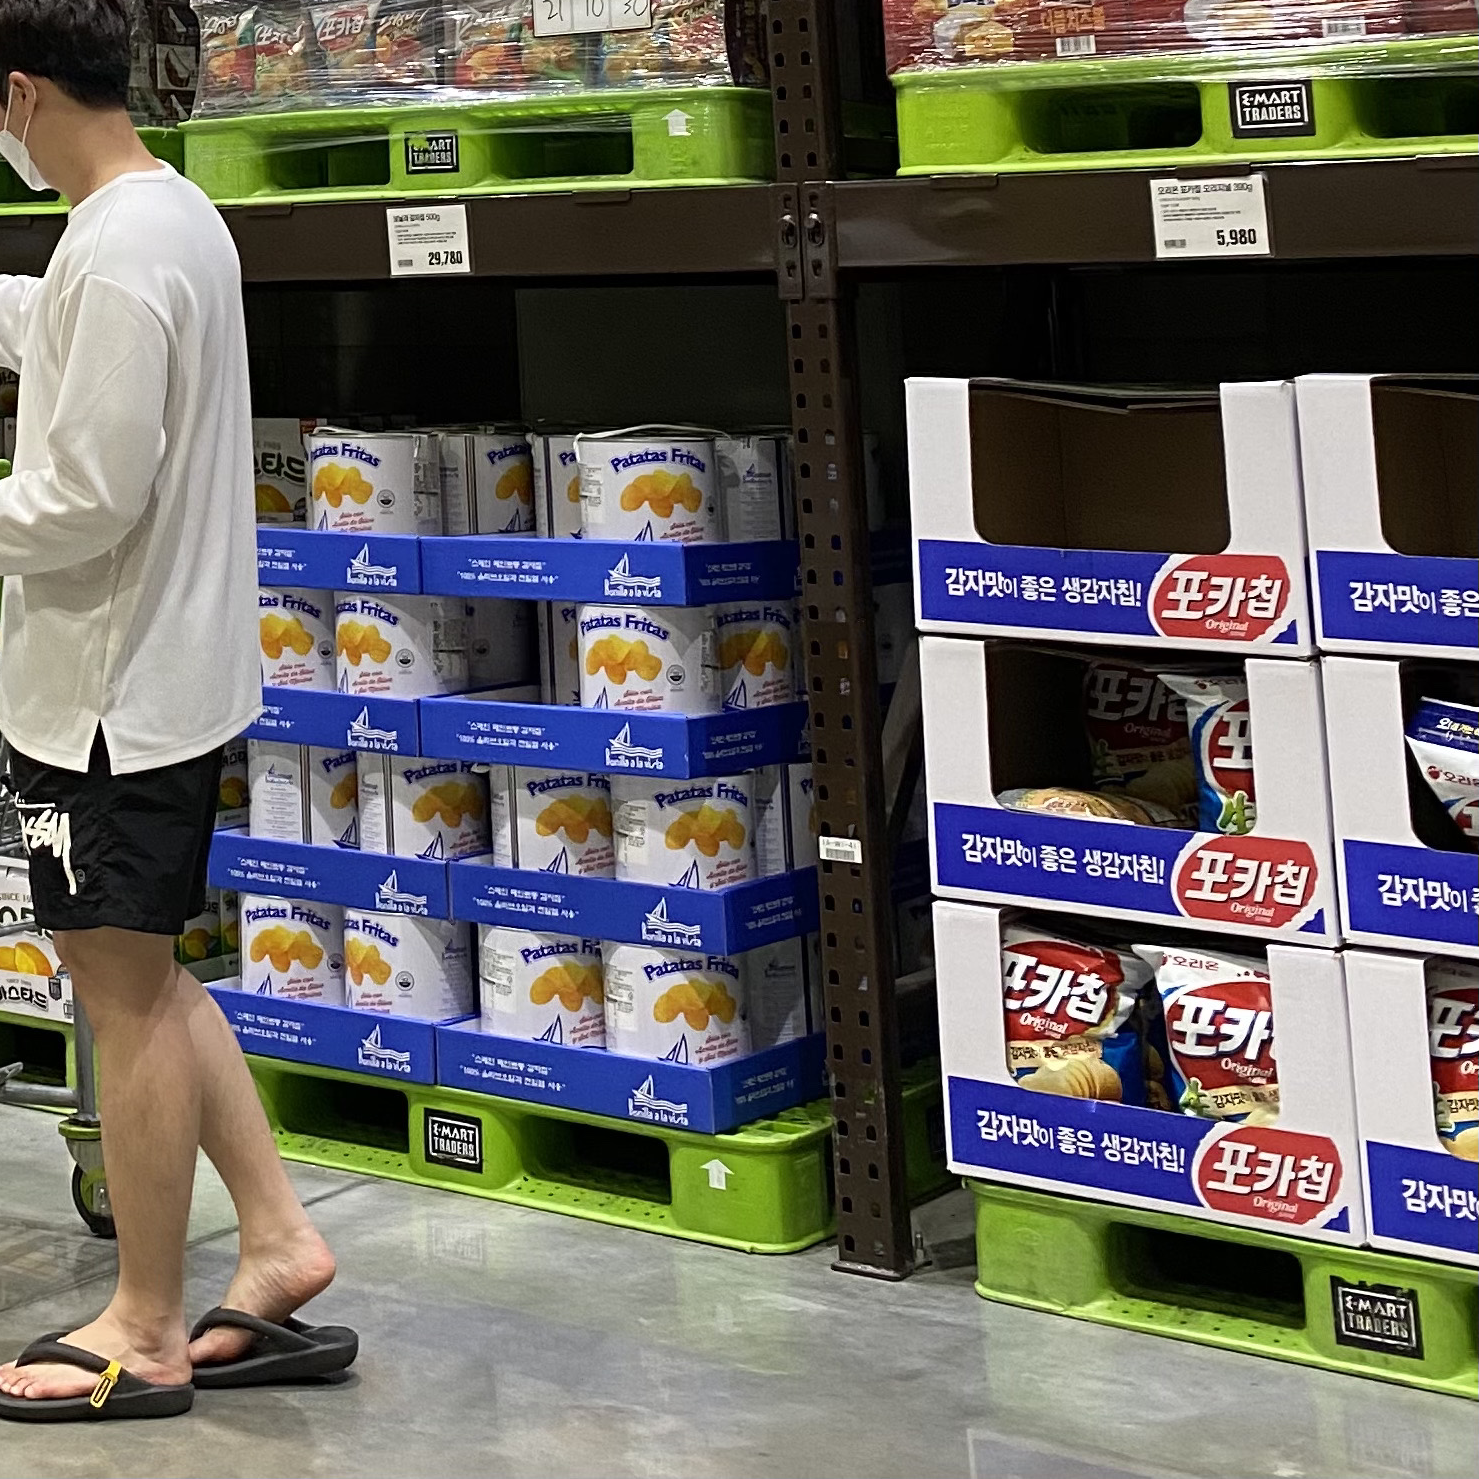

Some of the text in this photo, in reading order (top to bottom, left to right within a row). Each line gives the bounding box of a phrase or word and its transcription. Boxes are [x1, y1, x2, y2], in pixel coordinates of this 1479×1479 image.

[1240, 90, 1300, 107] E-MART
[1242, 103, 1302, 123] TRADERS
[1216, 229, 1256, 247] 5,980
[428, 251, 463, 266] 29,780
[341, 443, 381, 468] Fritas
[610, 448, 706, 474] Patatas Fritas
[944, 567, 1142, 608] 감자맛이 좋은 생감자칩!
[1161, 569, 1284, 620] 포카칩
[1349, 581, 1438, 614] 감자맛이
[624, 614, 670, 642] Fritas
[1205, 618, 1249, 634] Original
[527, 772, 584, 796] Patatas
[962, 834, 1165, 885] 감자맛이 좋은 생감자칩!
[1183, 849, 1311, 906] 포카칩
[1378, 874, 1468, 912] 감자맛이
[245, 904, 331, 930] Patatas Fritas
[1230, 902, 1275, 919] Original
[522, 940, 579, 963] Patatas
[1171, 954, 1220, 974] 오리온
[644, 957, 703, 981] Patatas
[1003, 955, 1108, 1025] 포카칩
[1020, 1012, 1069, 1037] Original
[1171, 993, 1273, 1061] 포카
[1220, 1057, 1274, 1079] Original
[433, 1123, 477, 1143] E-MART
[977, 1109, 1186, 1174] 감자맛이 좋은 생감자칩!
[433, 1135, 476, 1159] TRADERS
[1206, 1141, 1335, 1203] 포카칩
[1253, 1196, 1299, 1215] Original
[1345, 1295, 1407, 1320] E-MART
[1346, 1311, 1410, 1341] TRADERS
